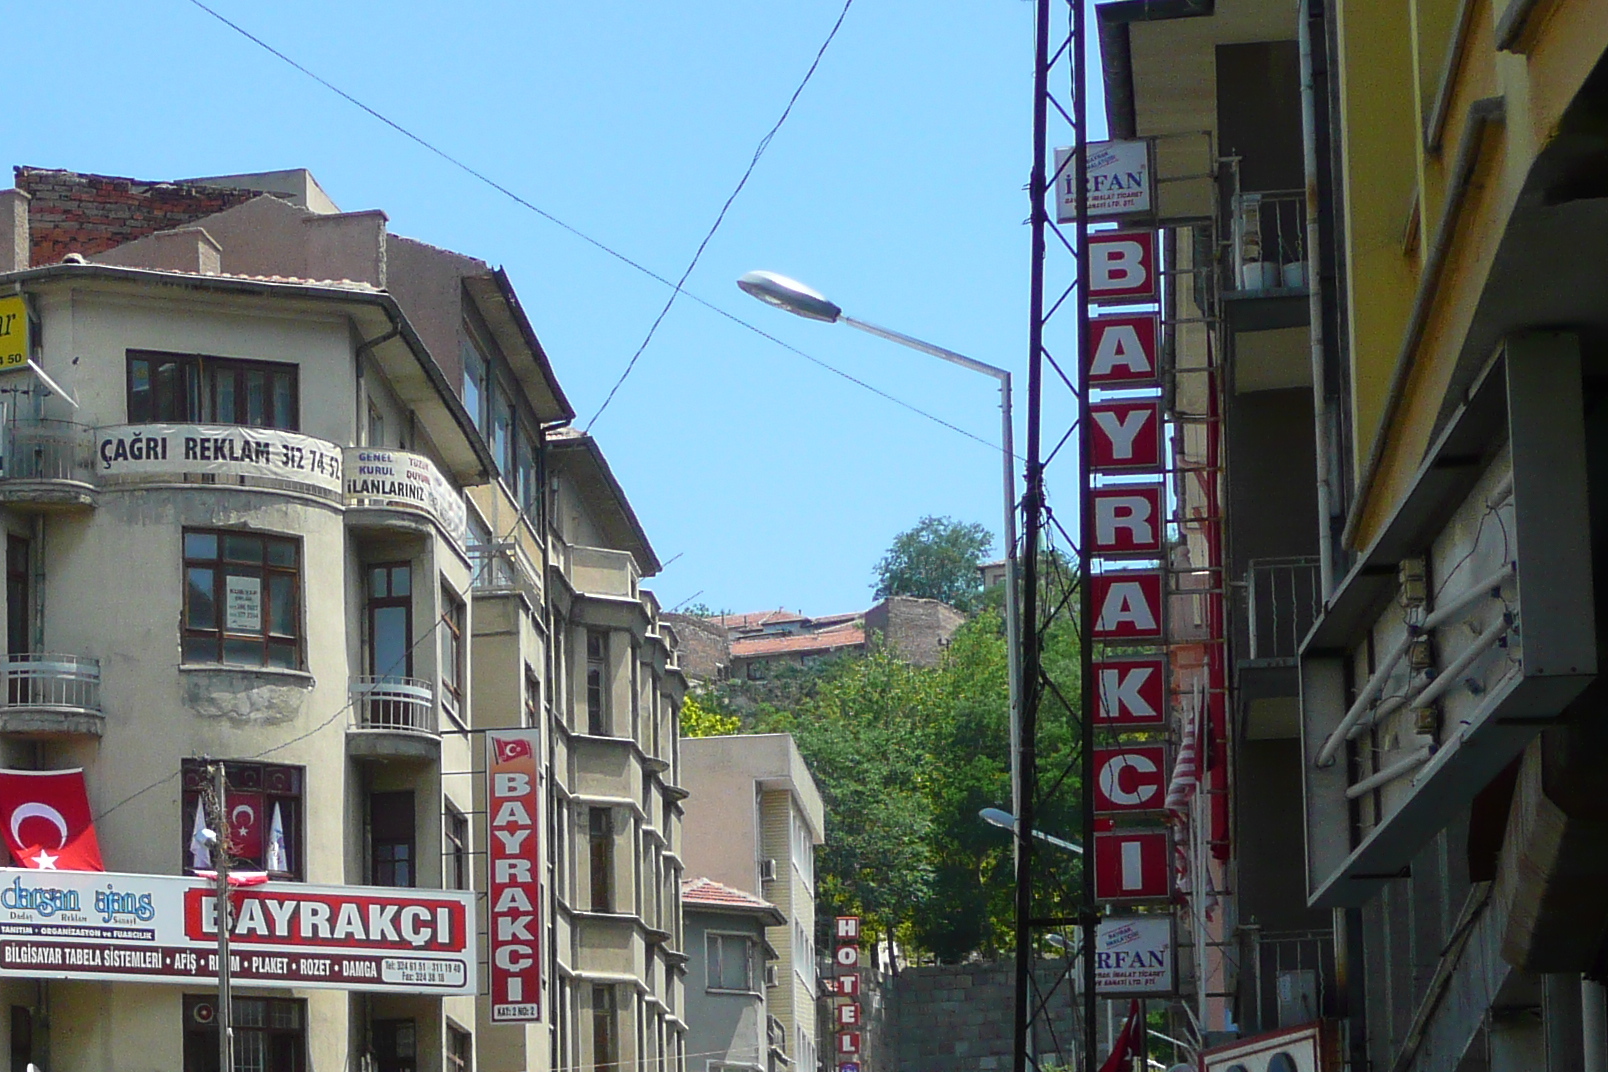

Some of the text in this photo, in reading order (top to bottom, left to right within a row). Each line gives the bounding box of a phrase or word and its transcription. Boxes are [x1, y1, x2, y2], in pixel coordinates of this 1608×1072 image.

[1065, 171, 1143, 195] İFAN
[7, 352, 22, 364] 50
[100, 432, 167, 470] ÇAĞRI
[184, 437, 270, 465] REKLAM
[281, 444, 304, 469] 312
[309, 450, 326, 474] 74
[359, 452, 394, 462] GENEL
[359, 465, 395, 476] KURUL
[493, 772, 534, 1002] BAYRAKÇI
[94, 883, 155, 923] ajans
[5, 942, 62, 965] BİLGİSAYAR
[64, 947, 102, 966] TABELA
[104, 945, 162, 968] SİSTEMLERİ
[174, 950, 196, 974] AFİŞ
[252, 956, 288, 975] PLAKET
[300, 959, 331, 976] ROZET
[343, 960, 377, 978] DAMGA
[1096, 950, 1165, 969] RFAN
[838, 918, 859, 1054] HOTEL
